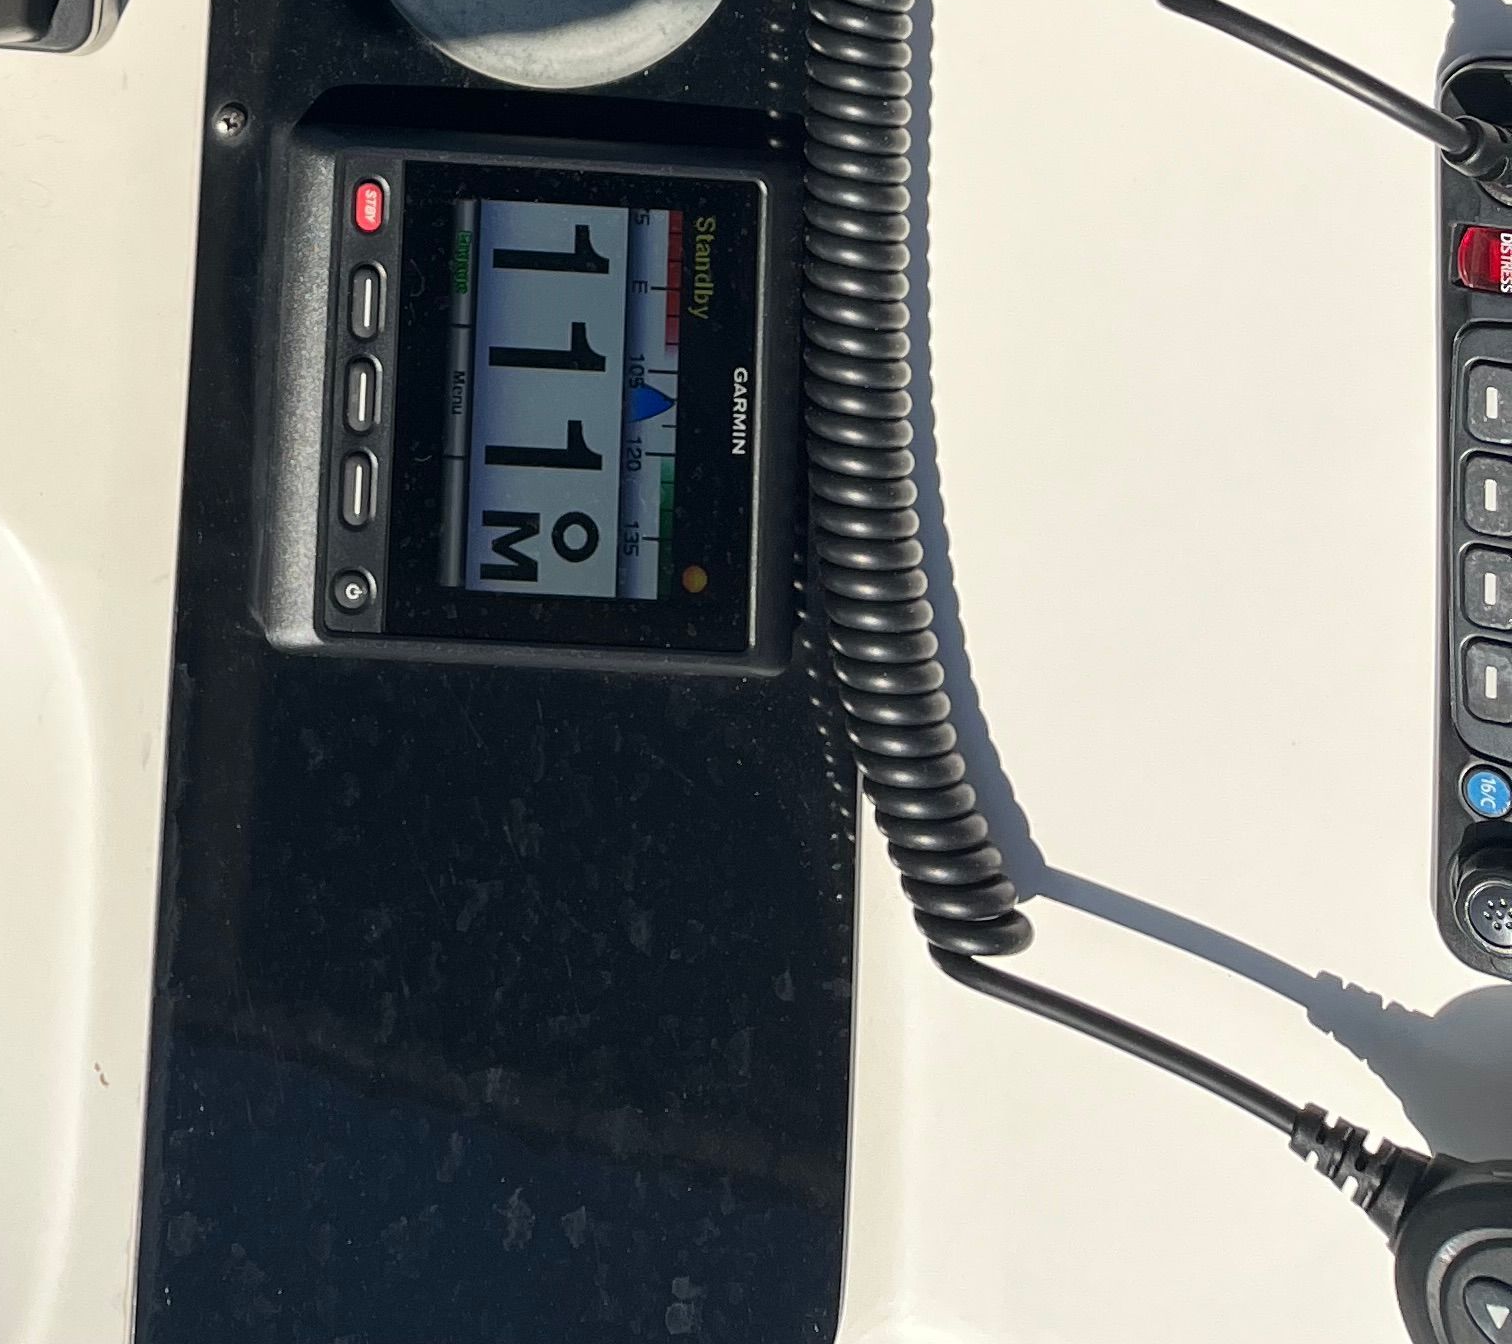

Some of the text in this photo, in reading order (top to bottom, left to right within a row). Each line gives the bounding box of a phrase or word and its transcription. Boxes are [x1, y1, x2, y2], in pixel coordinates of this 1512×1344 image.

[363, 188, 377, 226] STBY
[687, 216, 717, 321] Standby
[1500, 232, 1512, 293] DISTRESS
[451, 370, 466, 415] Menu
[731, 367, 749, 456] GARMIN
[625, 437, 642, 472] 120
[623, 521, 639, 557] 135
[1479, 777, 1497, 808] 16/C
